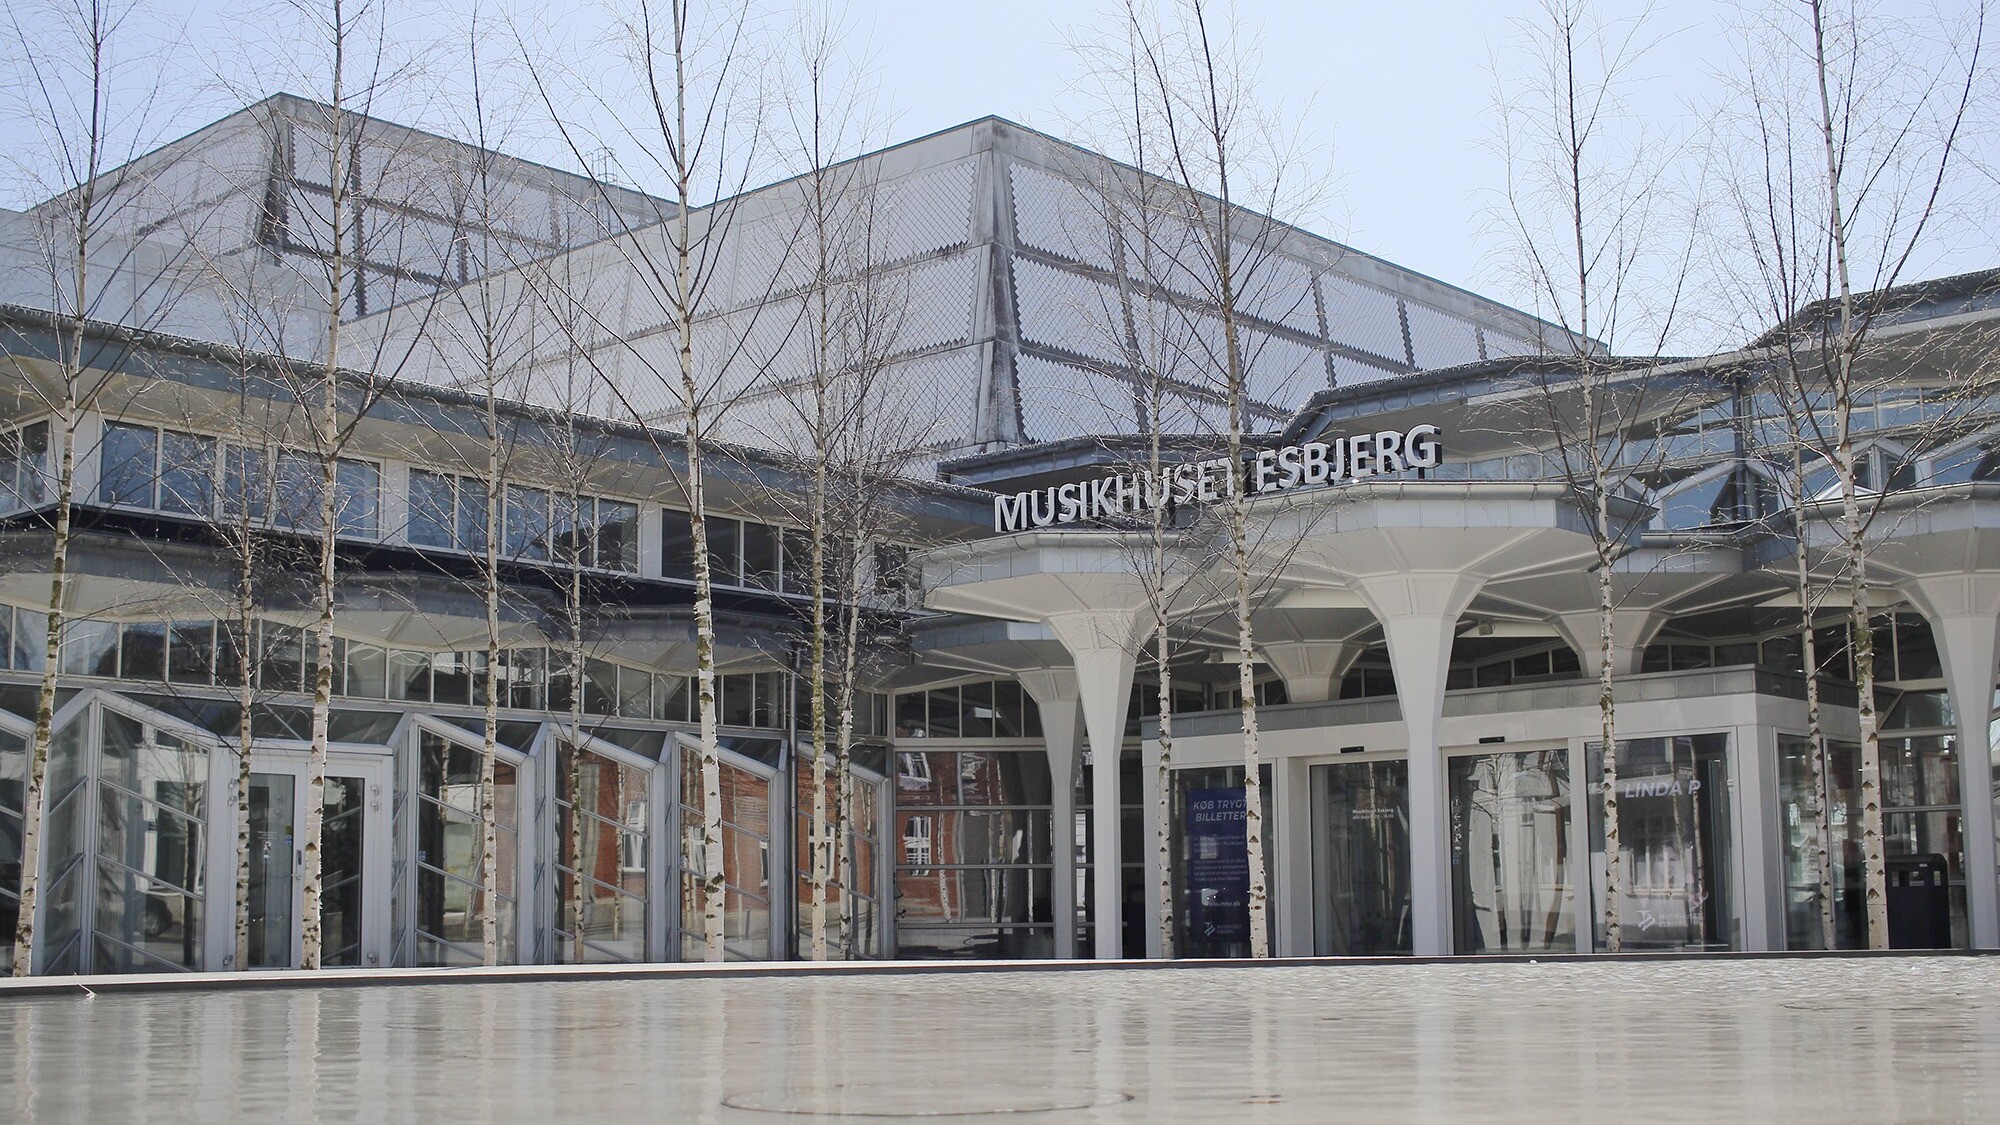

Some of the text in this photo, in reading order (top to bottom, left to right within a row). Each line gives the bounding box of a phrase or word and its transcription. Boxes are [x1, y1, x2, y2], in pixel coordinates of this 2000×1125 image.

[994, 424, 1441, 533] MUSIKHUSET ESBJERG
[1625, 780, 1701, 798] LINDA P
[1193, 800, 1214, 810] KØB
[1195, 811, 1246, 822] BILLETTER
